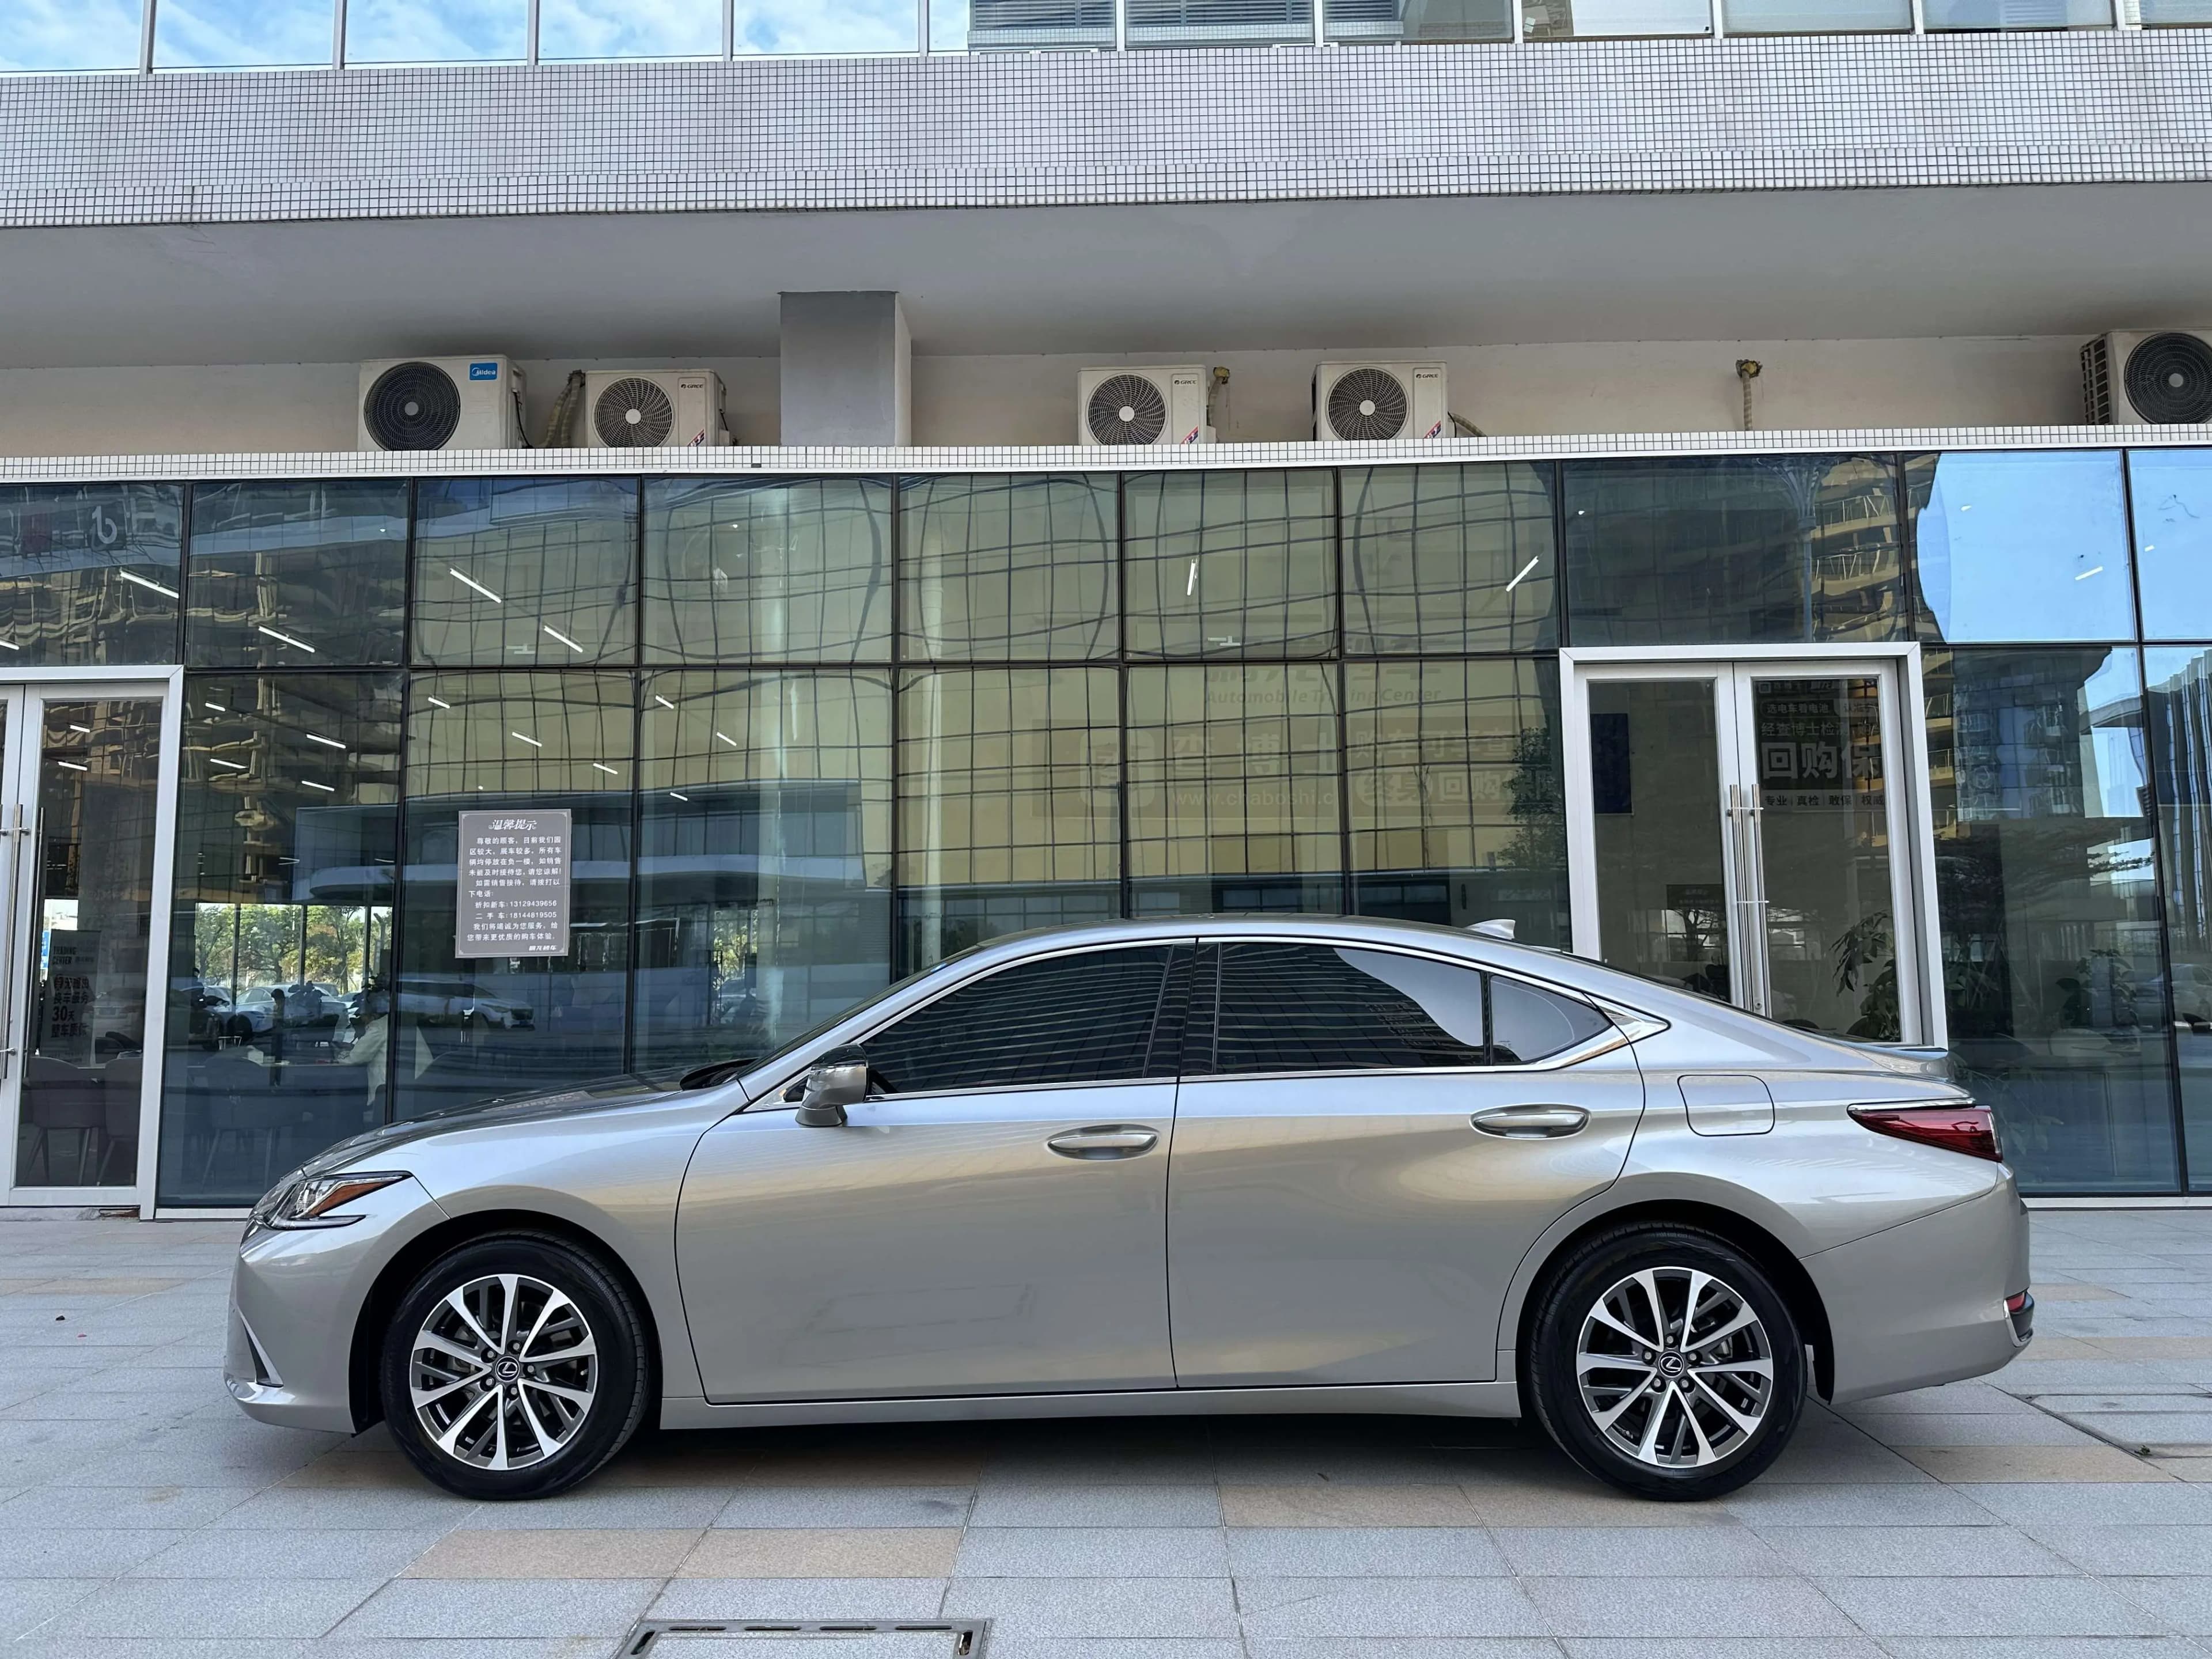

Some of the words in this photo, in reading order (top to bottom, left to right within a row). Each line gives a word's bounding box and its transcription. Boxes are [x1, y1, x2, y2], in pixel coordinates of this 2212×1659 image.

[472, 368, 496, 376] Midea
[1205, 689, 1308, 704] Automobile
[1309, 688, 1377, 704] Tring
[1379, 686, 1441, 702] Center
[1173, 789, 1335, 806] www.chaboshi.c
[491, 819, 537, 831] 温馨提示
